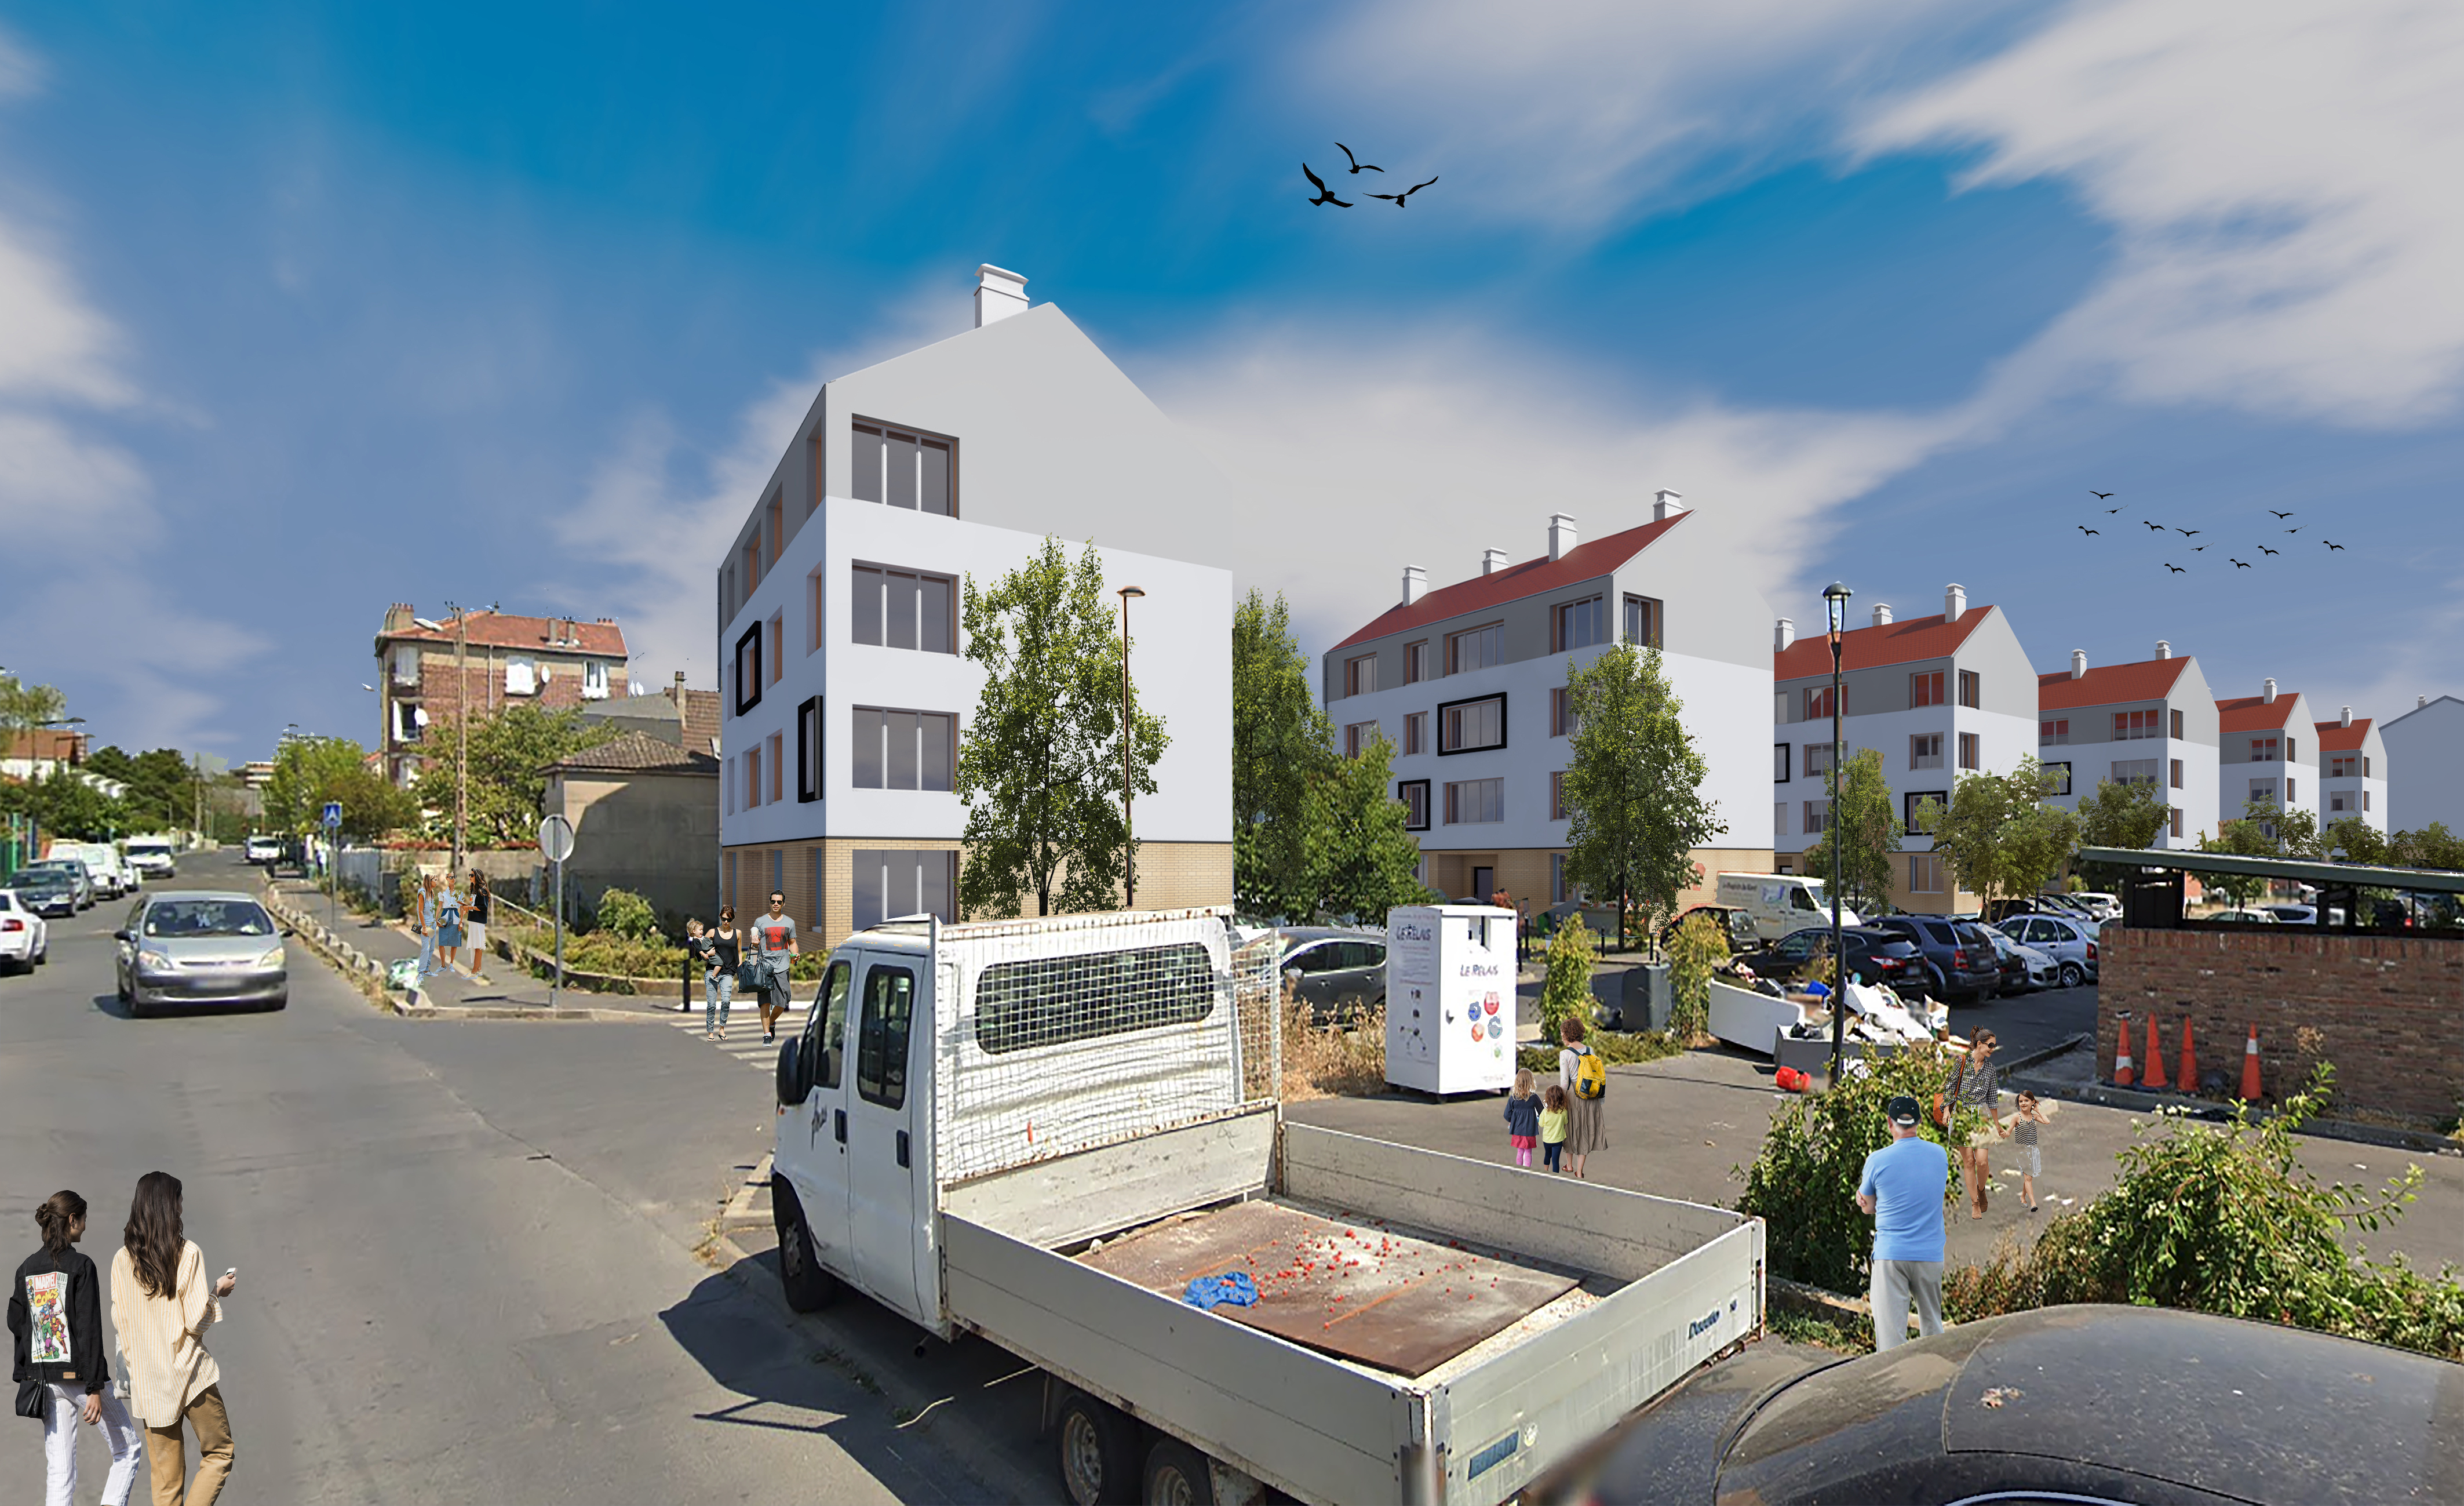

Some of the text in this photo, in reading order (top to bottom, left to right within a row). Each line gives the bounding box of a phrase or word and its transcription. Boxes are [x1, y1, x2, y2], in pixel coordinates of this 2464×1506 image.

[1396, 926, 1405, 940] LE
[1460, 964, 1470, 976] LE
[35, 1274, 55, 1290] MARVEL
